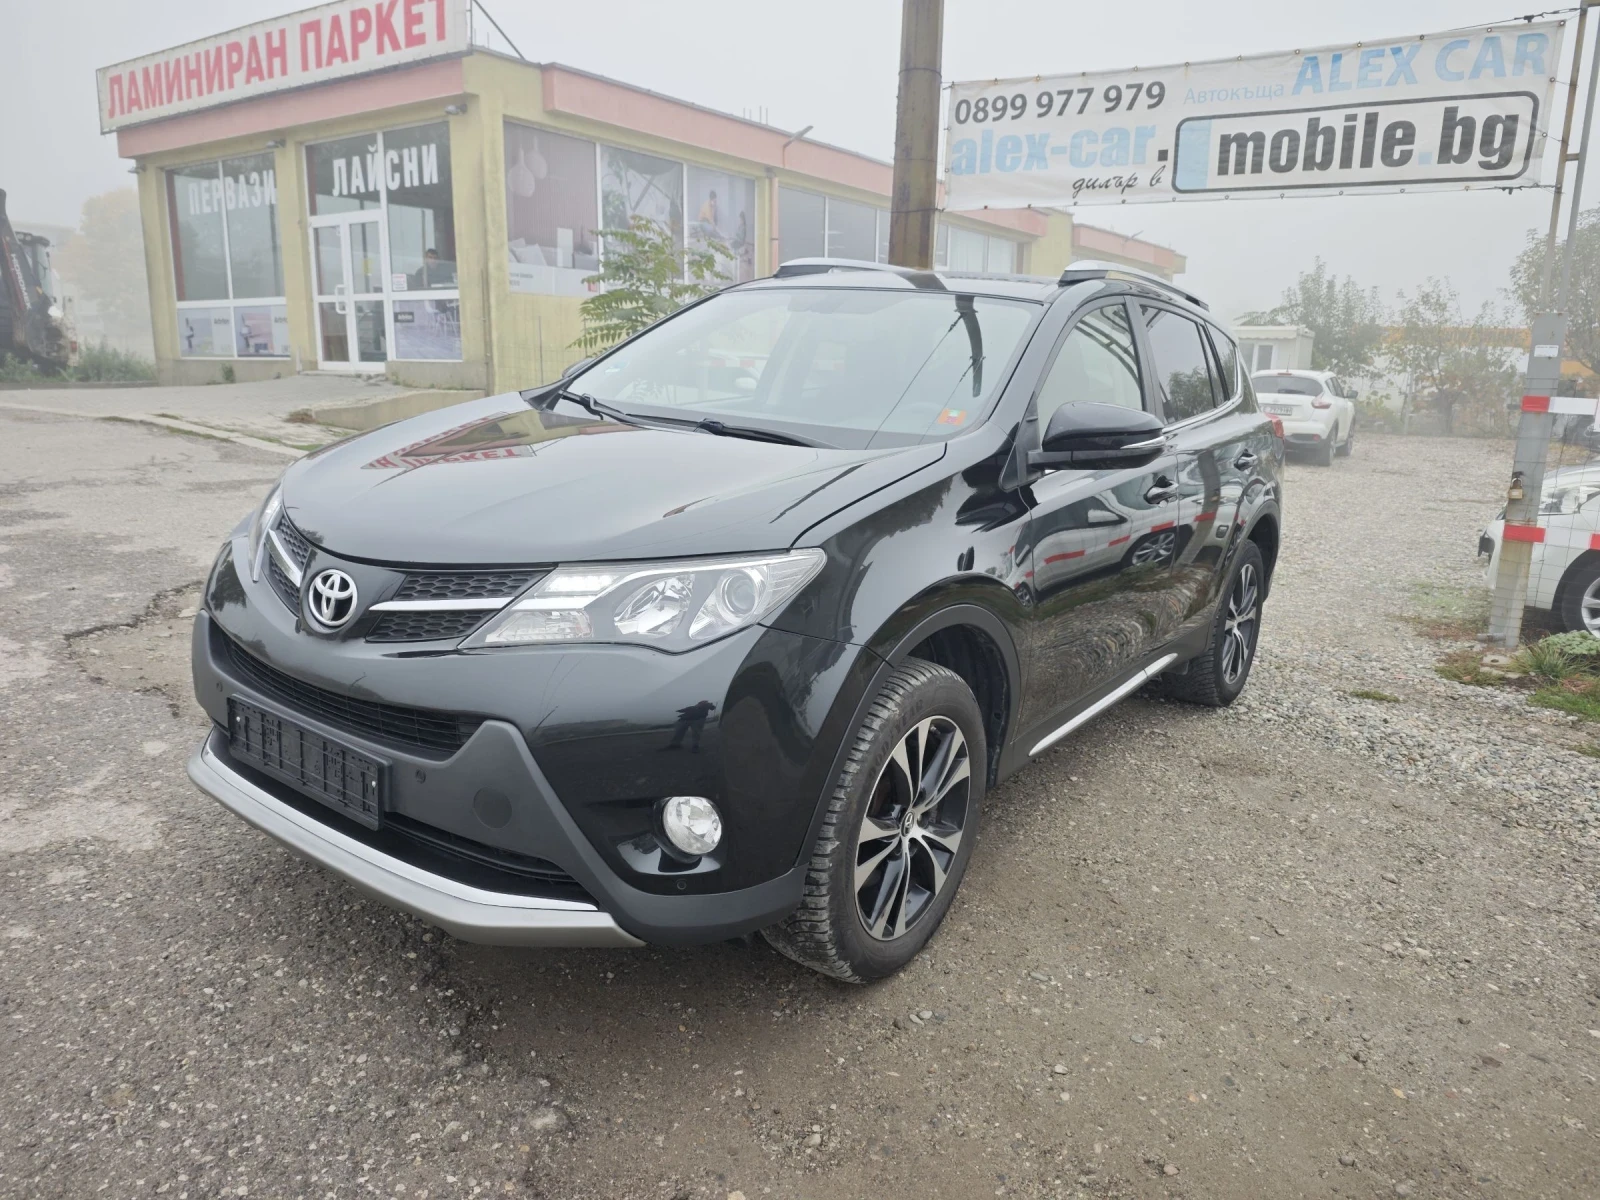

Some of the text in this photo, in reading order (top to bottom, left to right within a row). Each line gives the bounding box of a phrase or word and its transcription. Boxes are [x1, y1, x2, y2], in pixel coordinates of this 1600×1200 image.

[108, 0, 446, 119] ЛАМИНИРАН ПАРКЕТ
[1291, 32, 1550, 96] ALEX CAR
[955, 81, 1166, 124] 0899 977 979
[1183, 83, 1284, 105] Автокъща
[1217, 106, 1519, 176] mobile.bg
[188, 169, 276, 215] ПЕРВАЗИ
[332, 143, 438, 197] ЛАЙСНИ
[1072, 172, 1138, 199] дилър
